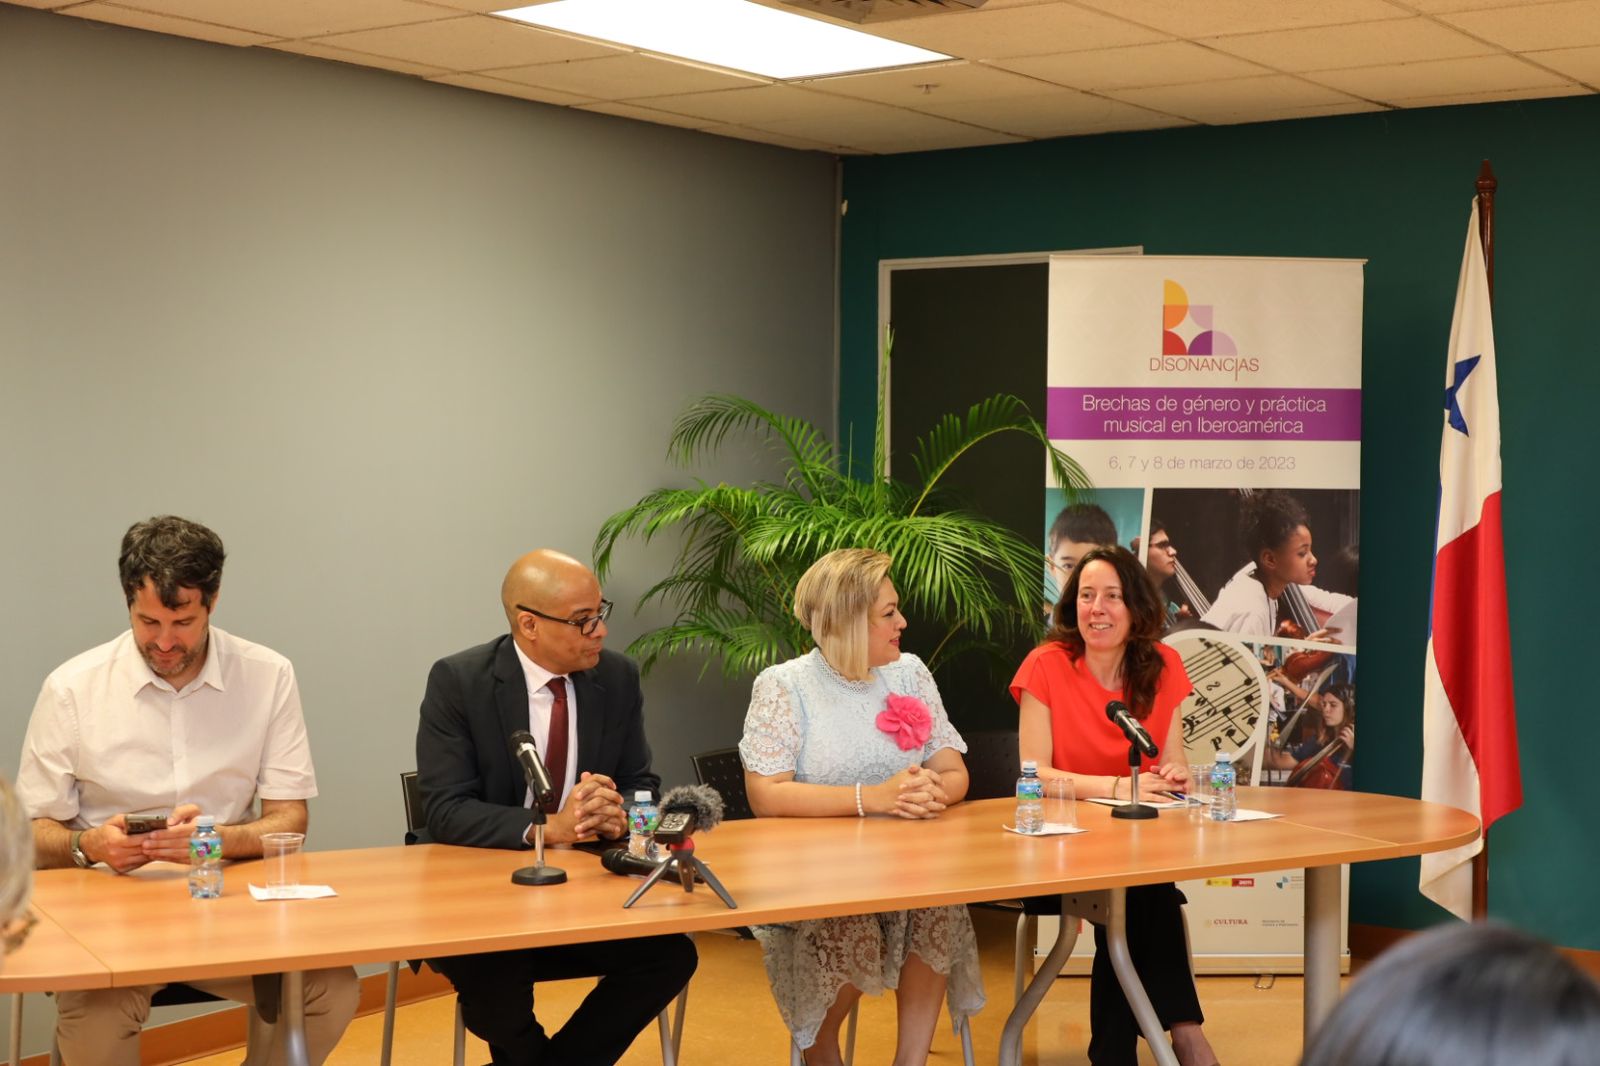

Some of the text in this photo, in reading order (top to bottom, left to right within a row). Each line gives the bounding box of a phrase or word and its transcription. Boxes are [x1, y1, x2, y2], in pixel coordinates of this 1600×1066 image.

[1150, 355, 1260, 381] DISONANCIAS
[1082, 394, 1327, 415] Brechas de género y práctica
[1103, 416, 1304, 434] musical en Iberoamérica
[1108, 456, 1296, 471] 6, 7 y 8 de marzo de 2023
